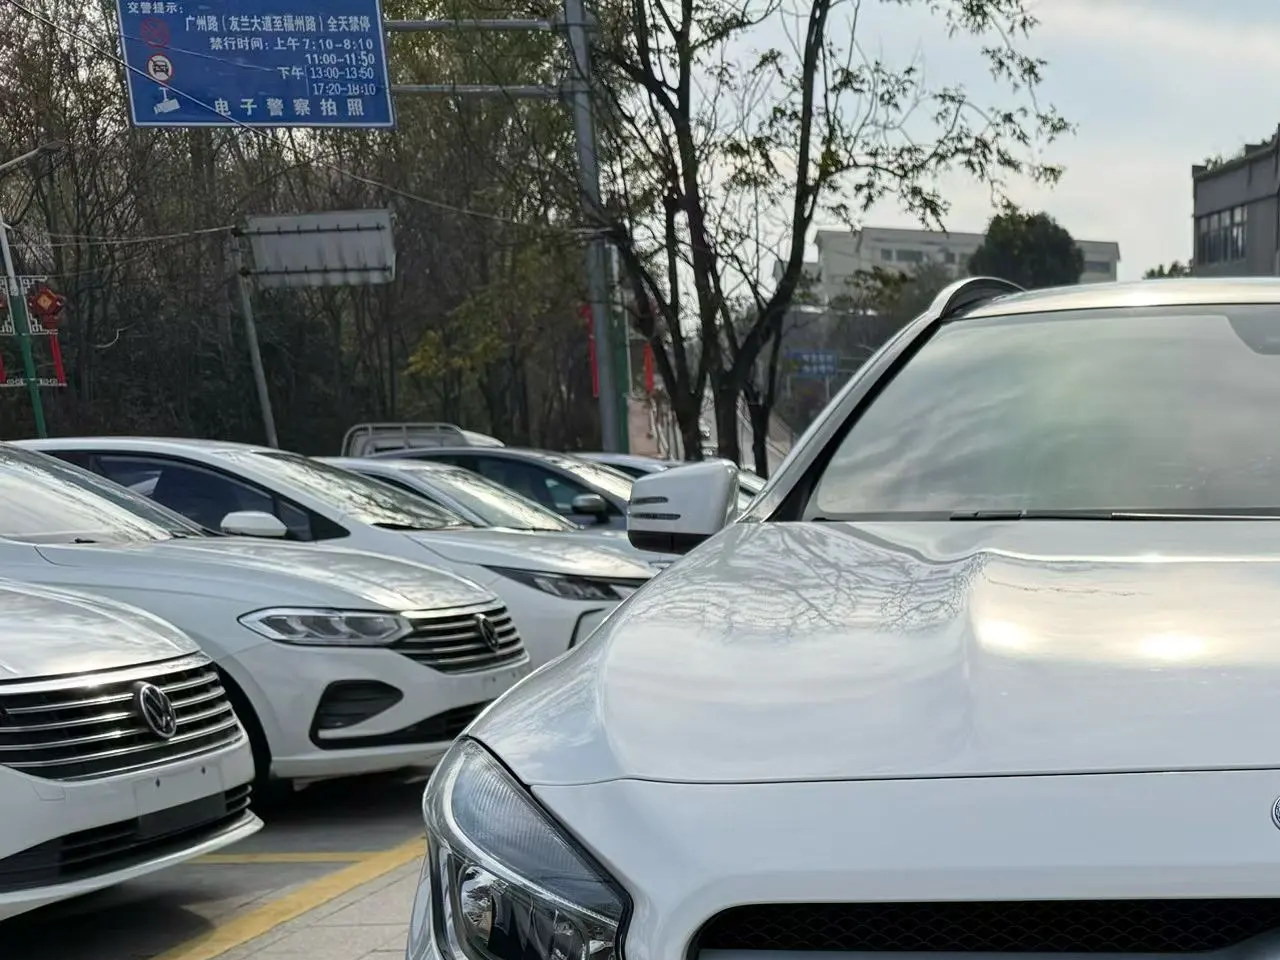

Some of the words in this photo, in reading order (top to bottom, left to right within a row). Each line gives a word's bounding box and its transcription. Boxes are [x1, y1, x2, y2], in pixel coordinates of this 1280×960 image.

[277, 66, 304, 79] 下午
[214, 98, 364, 117] 电子警察拍照
